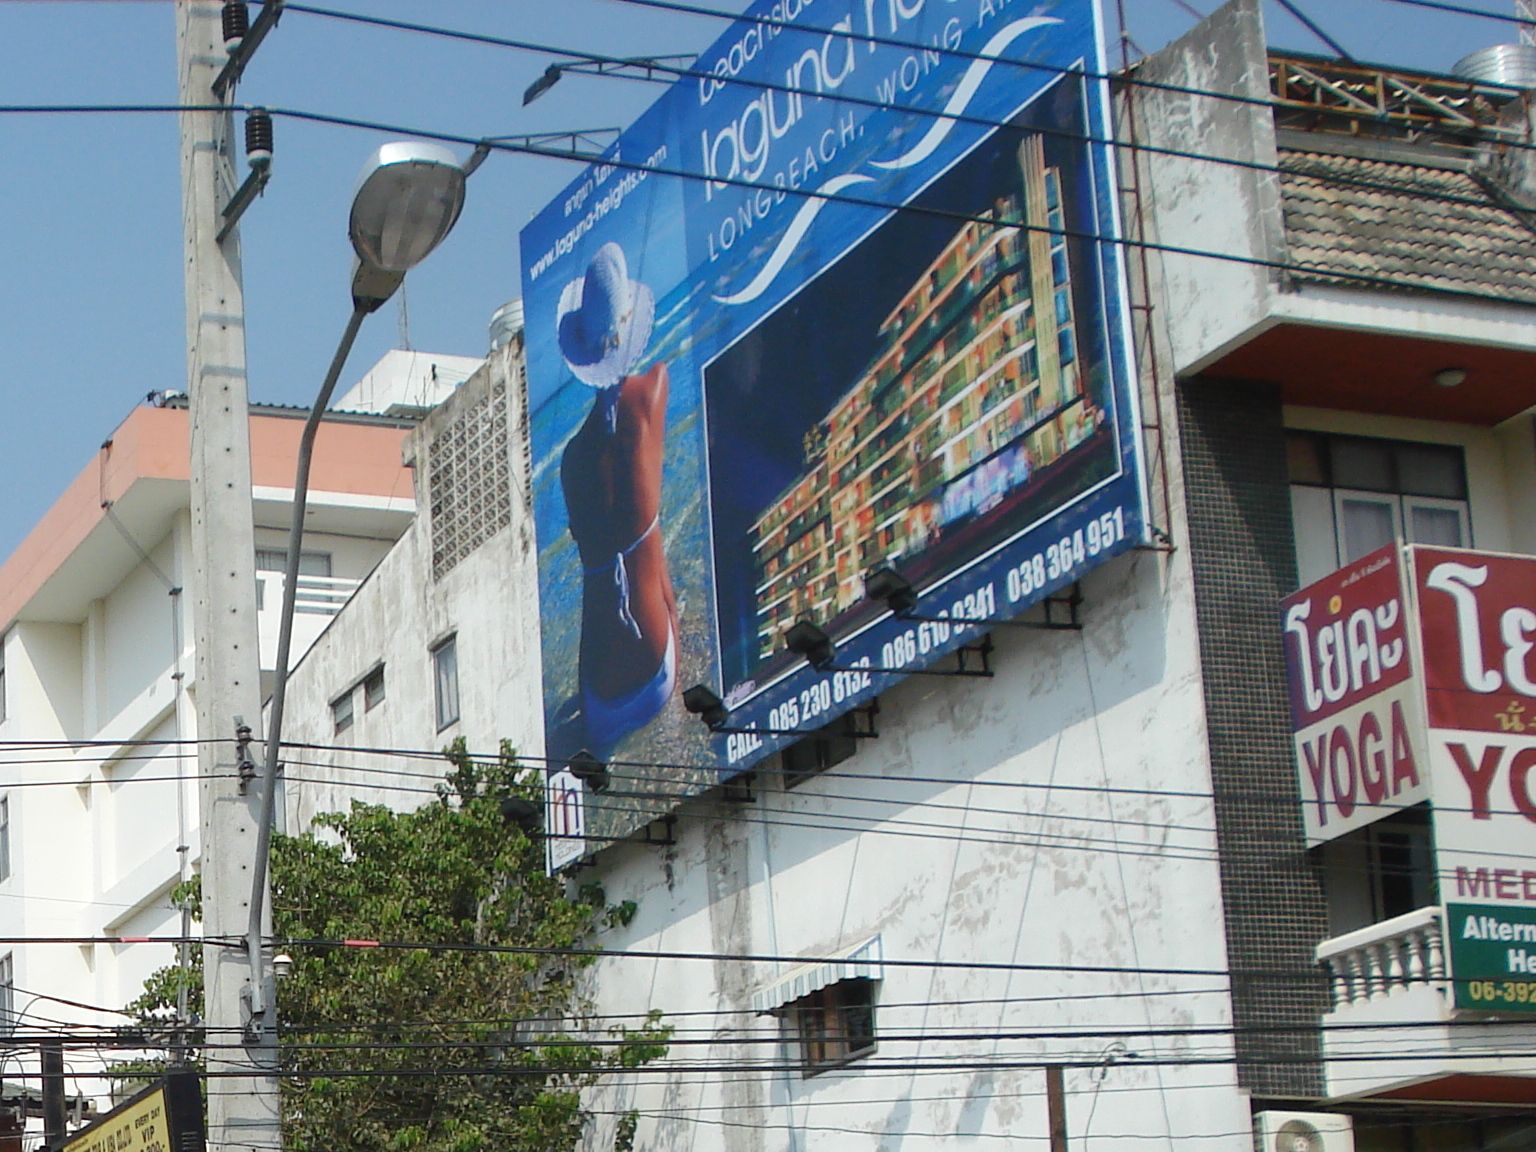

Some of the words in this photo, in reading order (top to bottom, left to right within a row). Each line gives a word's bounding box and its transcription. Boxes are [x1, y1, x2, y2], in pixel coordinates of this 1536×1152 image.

[699, 0, 814, 106] beachsid
[701, 13, 856, 202] laguna
[876, 17, 963, 111] WONG
[529, 145, 667, 281] www.laguna-heights.com
[769, 698, 798, 740] 085
[802, 678, 832, 722] 230
[833, 656, 872, 706] 8132
[883, 634, 915, 671] 086
[918, 611, 950, 655] 610
[953, 582, 995, 628] 9341
[1007, 555, 1045, 603] 038
[1047, 536, 1084, 582] 364
[1088, 505, 1124, 557] 951
[1285, 598, 1403, 712] โยคะ
[1301, 700, 1420, 828] YOGA
[135, 1114, 149, 1129] EVERY
[151, 1106, 160, 1119] DAY
[141, 1125, 155, 1143] VIP
